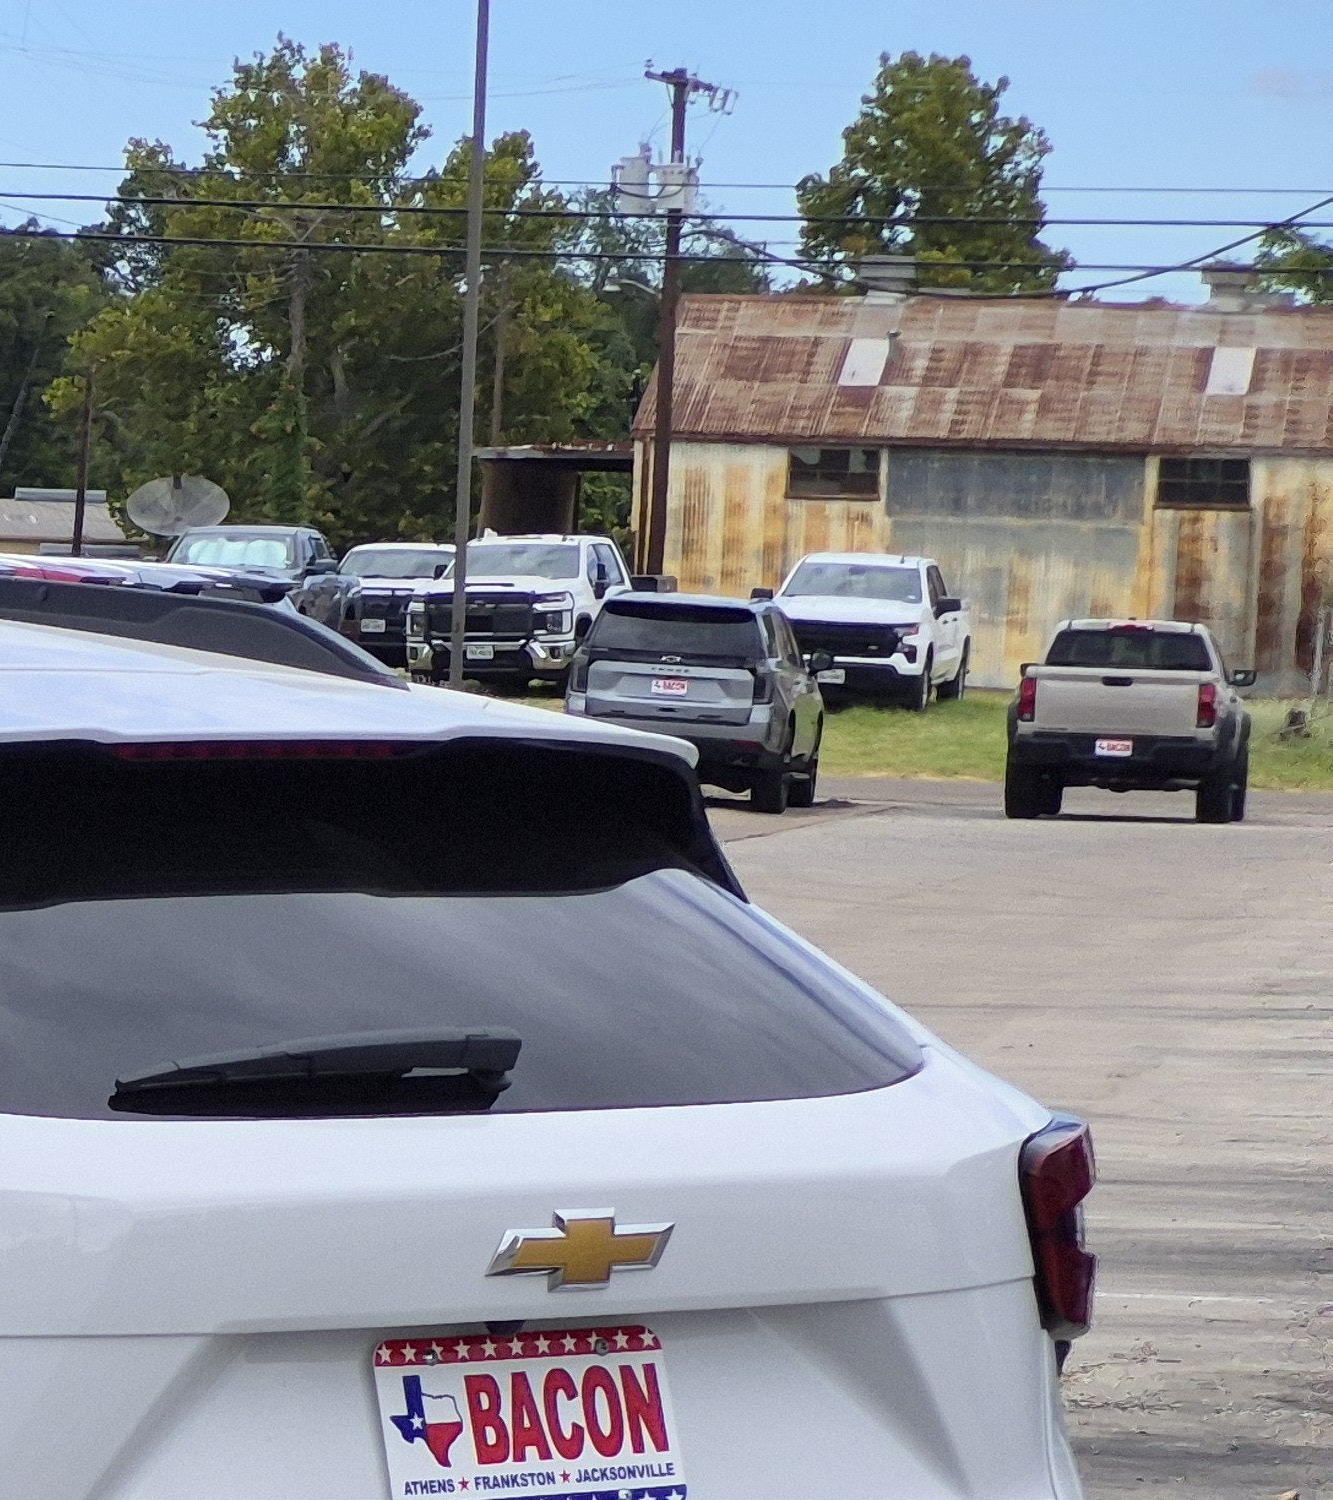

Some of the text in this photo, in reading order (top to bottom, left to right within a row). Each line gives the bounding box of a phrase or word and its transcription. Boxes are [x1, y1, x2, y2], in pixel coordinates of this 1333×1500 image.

[464, 1363, 670, 1465] BACON
[404, 1462, 676, 1496] ATHENS FRANKSTON JACKSONVILLE
